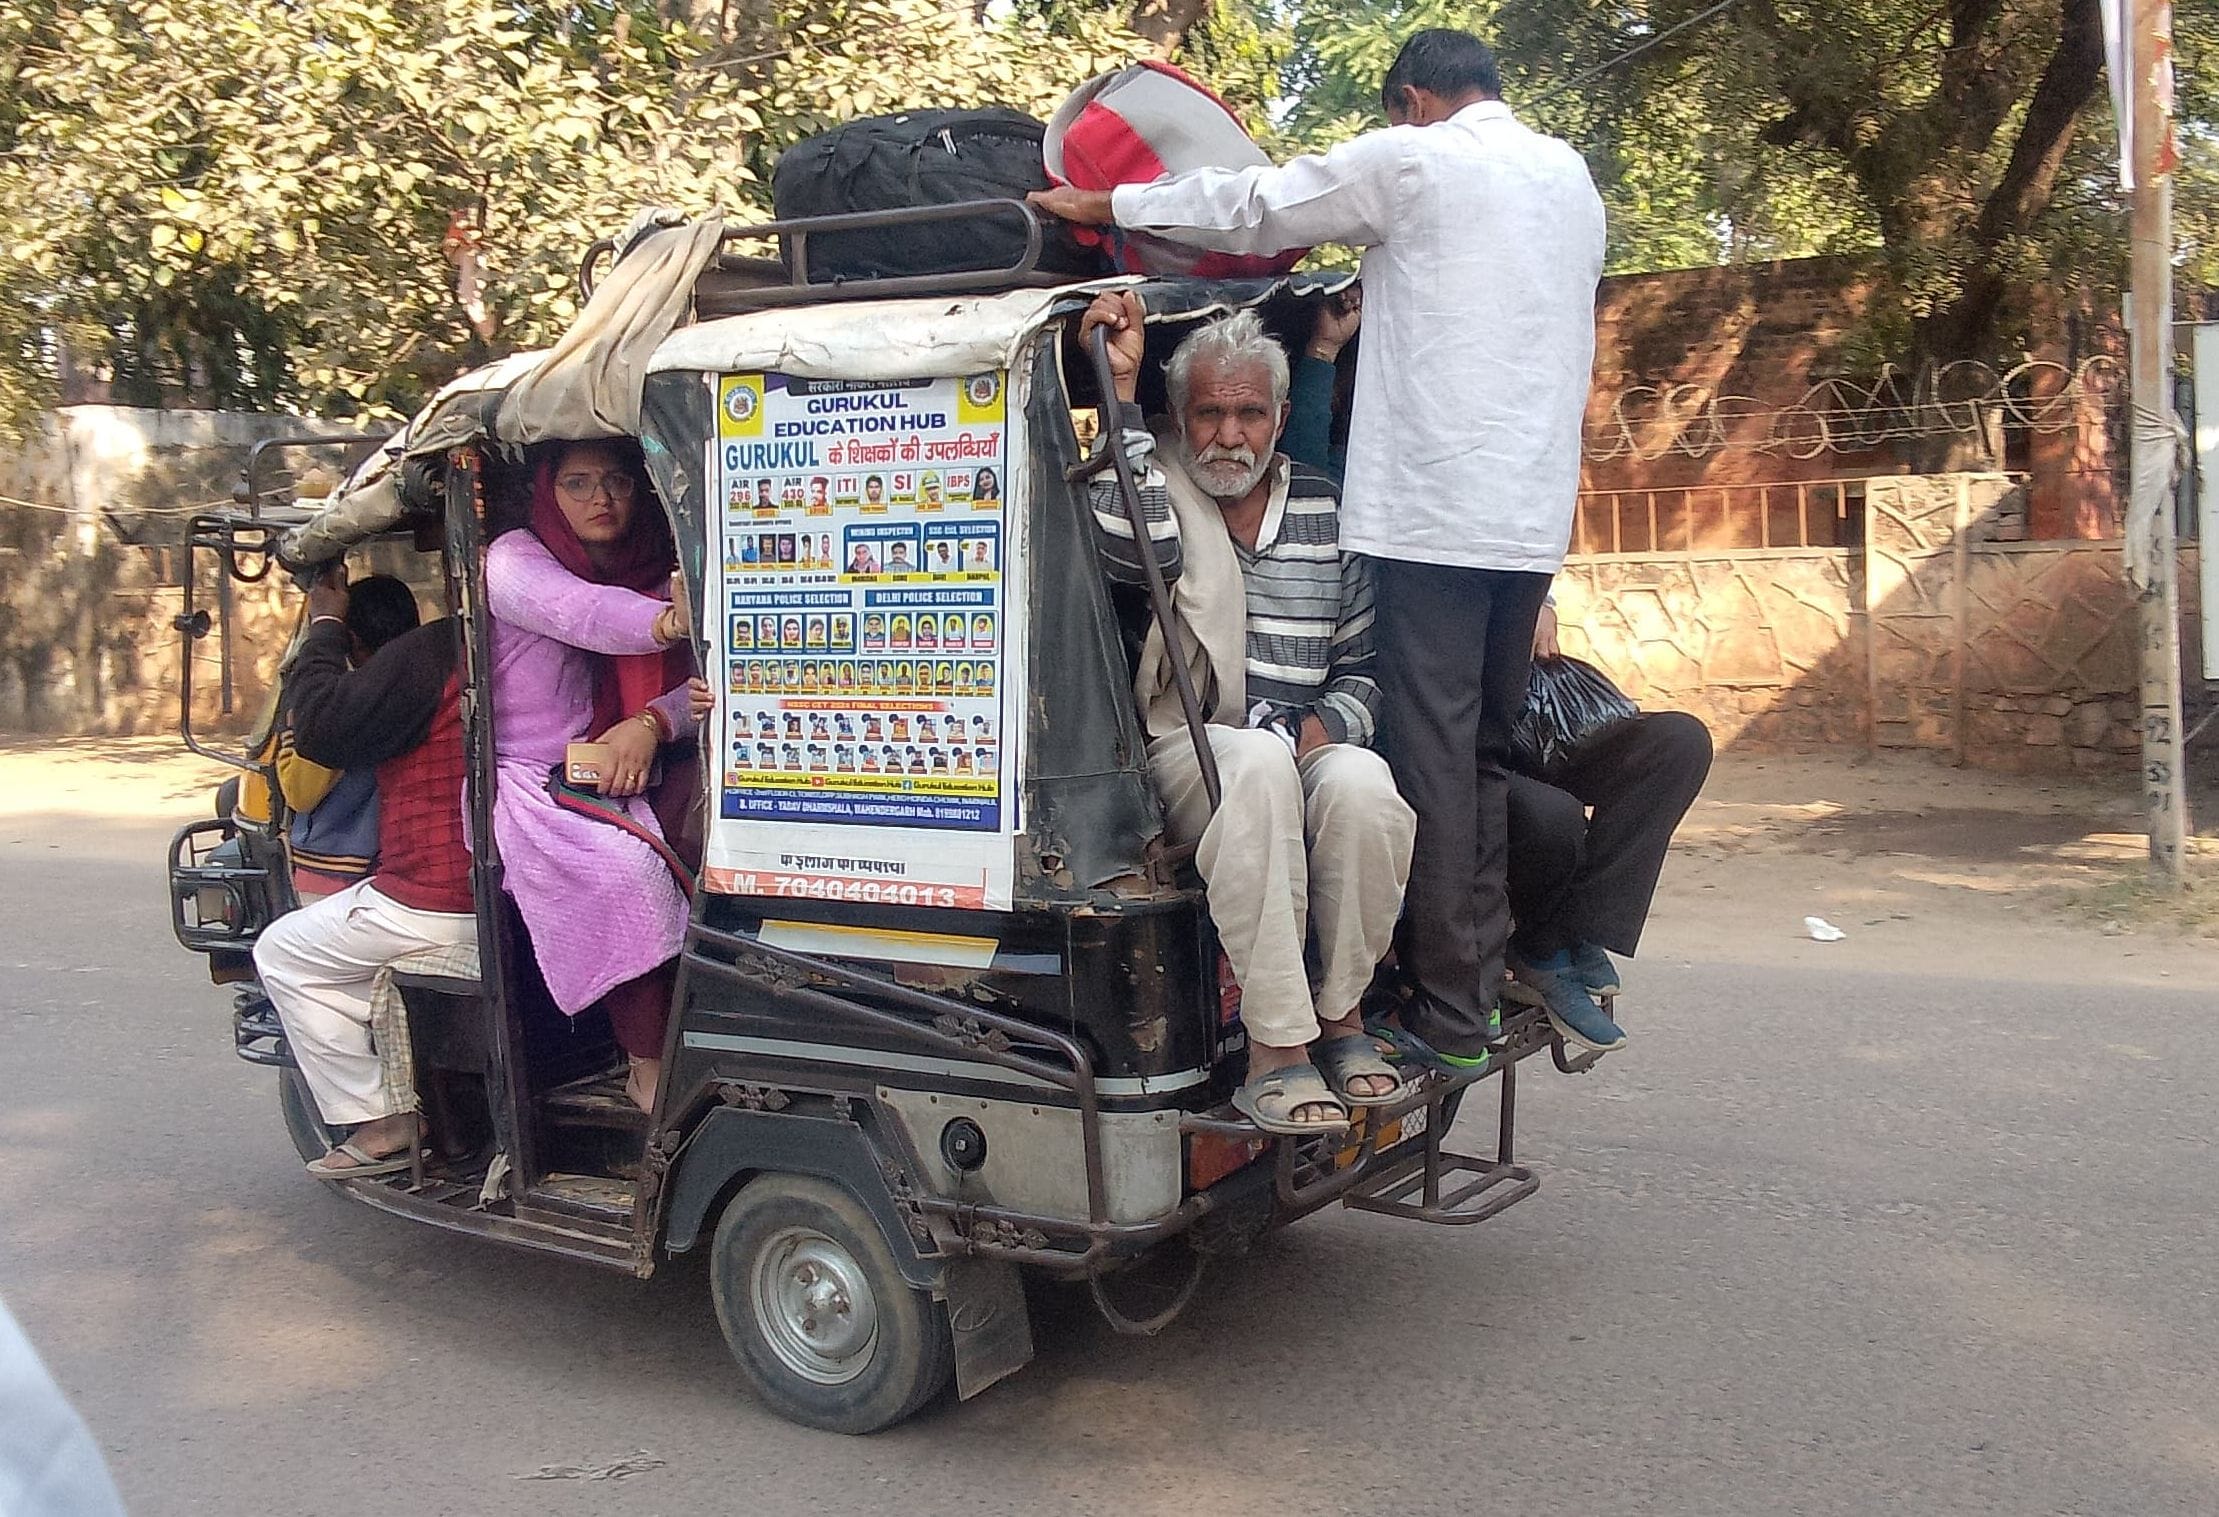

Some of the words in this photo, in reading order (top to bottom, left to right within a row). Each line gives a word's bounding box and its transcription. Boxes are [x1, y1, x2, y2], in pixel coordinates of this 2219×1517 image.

[807, 393, 909, 414] GURUKUL
[775, 416, 896, 438] EDUCATION
[900, 413, 946, 431] HUB
[726, 441, 820, 471] GURUKUL
[828, 441, 843, 465] के
[848, 437, 899, 465] शिक्षकों
[900, 435, 921, 462] की
[731, 480, 750, 489] AIR
[784, 478, 802, 487] AIR
[837, 478, 857, 493] ITI
[894, 474, 912, 490] SI
[947, 475, 970, 488] IBPS
[735, 594, 772, 606] HARYANA
[775, 593, 802, 605] POLICE
[805, 593, 849, 605] SELECTION
[876, 592, 901, 603] DELHI
[903, 591, 933, 603] POLICE
[936, 591, 983, 602] SELECTION
[774, 876, 955, 907] 7040404013
